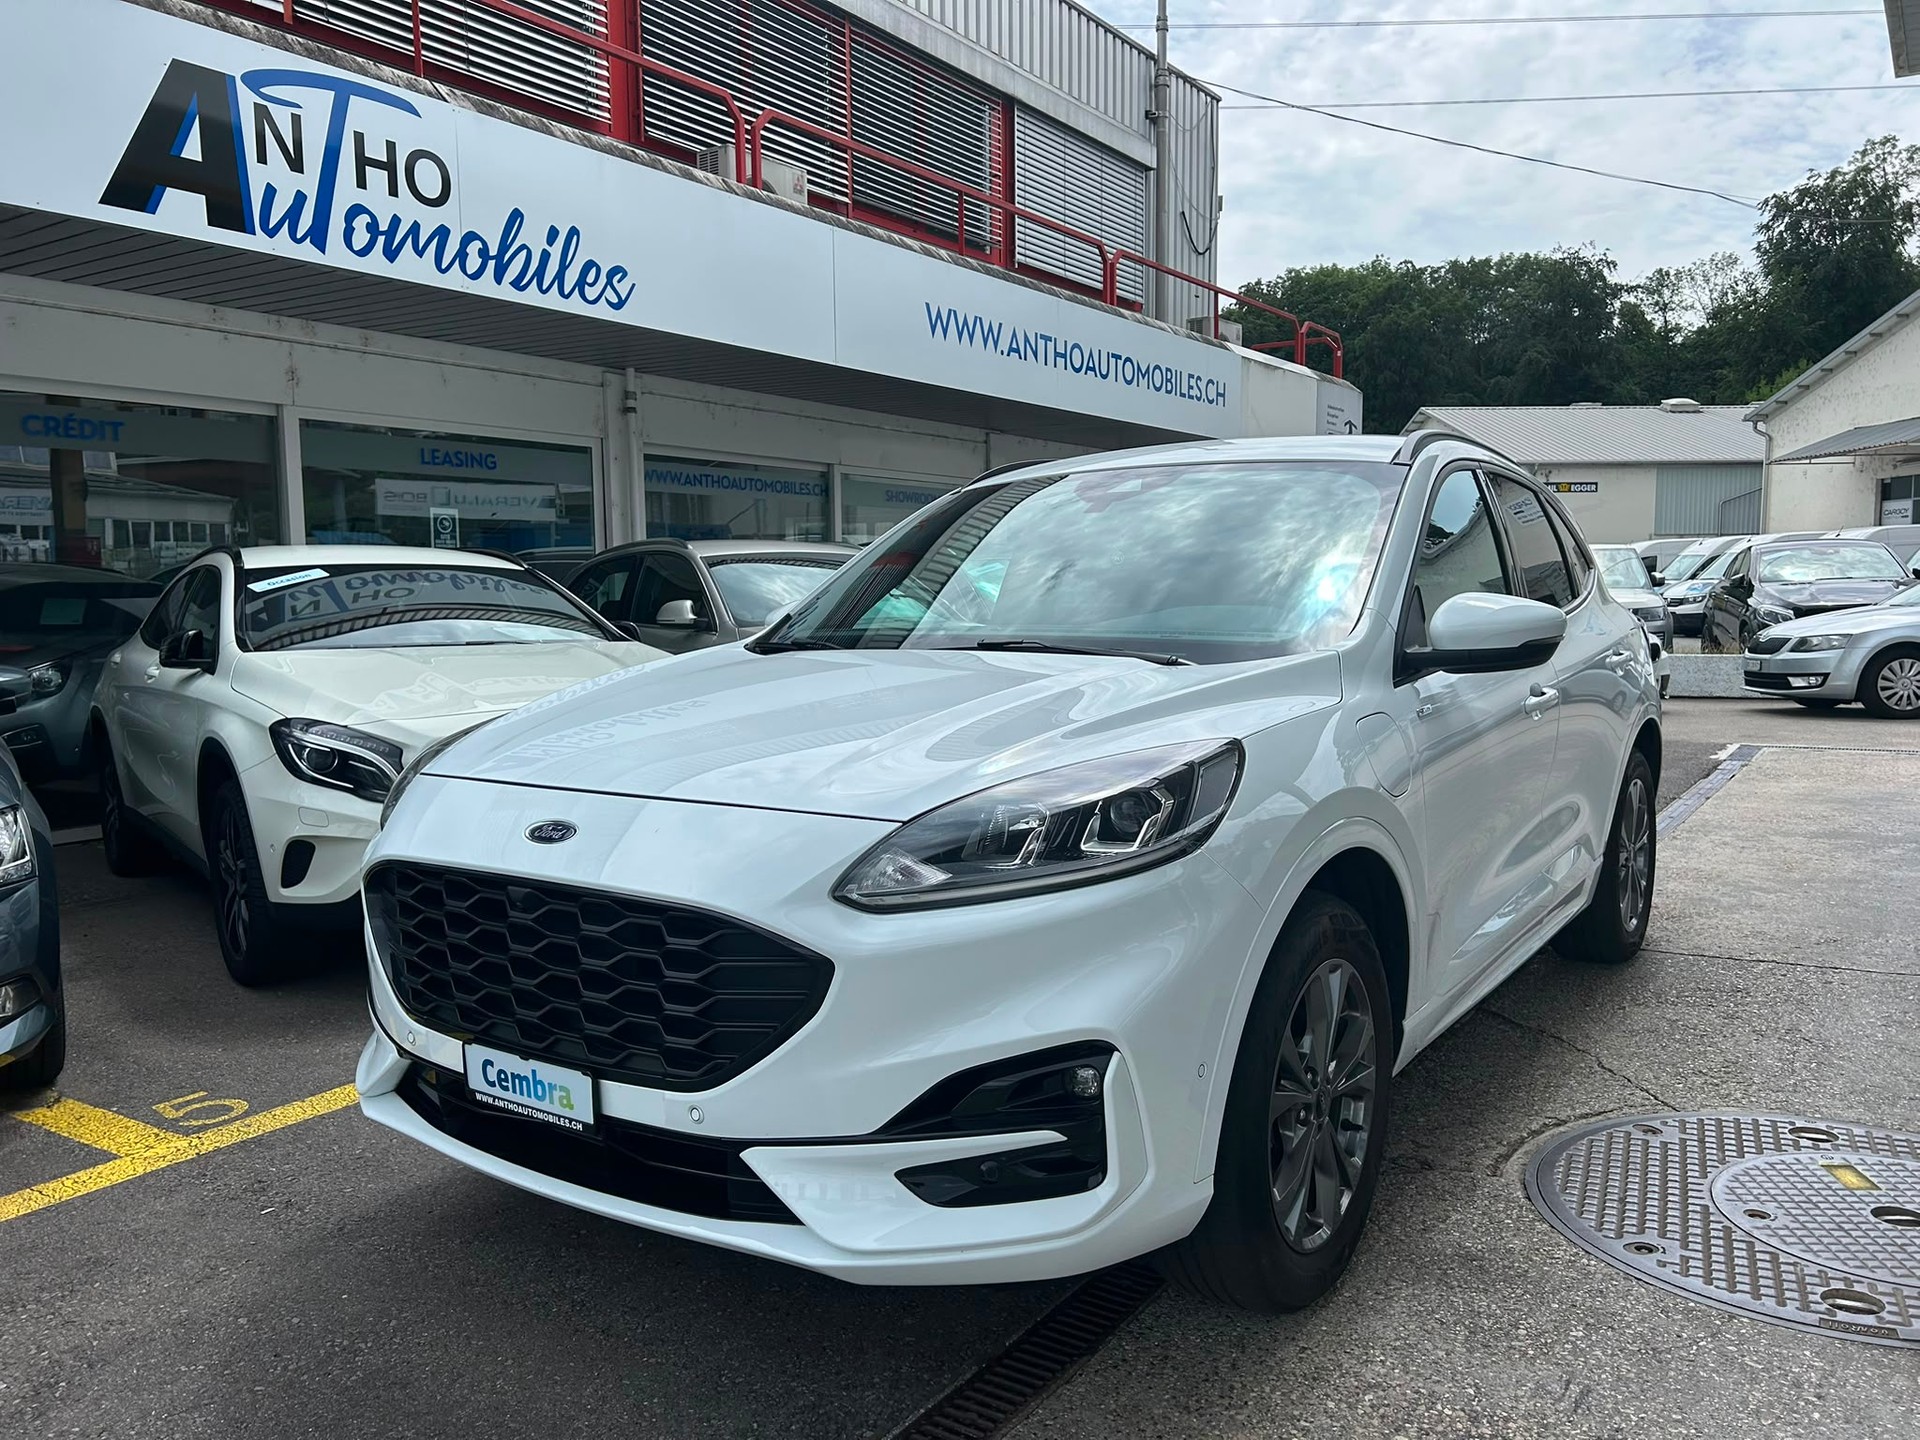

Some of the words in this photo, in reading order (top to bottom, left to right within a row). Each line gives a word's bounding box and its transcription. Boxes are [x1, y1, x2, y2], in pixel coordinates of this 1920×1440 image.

[925, 302, 1226, 408] WWW.ANTHOAUTOMOBILES.CH
[22, 413, 124, 442] CRÉDIT
[420, 448, 497, 470] LEASING
[1570, 484, 1597, 492] EGGER
[534, 825, 567, 839] Ford
[481, 1058, 575, 1111] Cembra
[152, 1090, 249, 1126] 5
